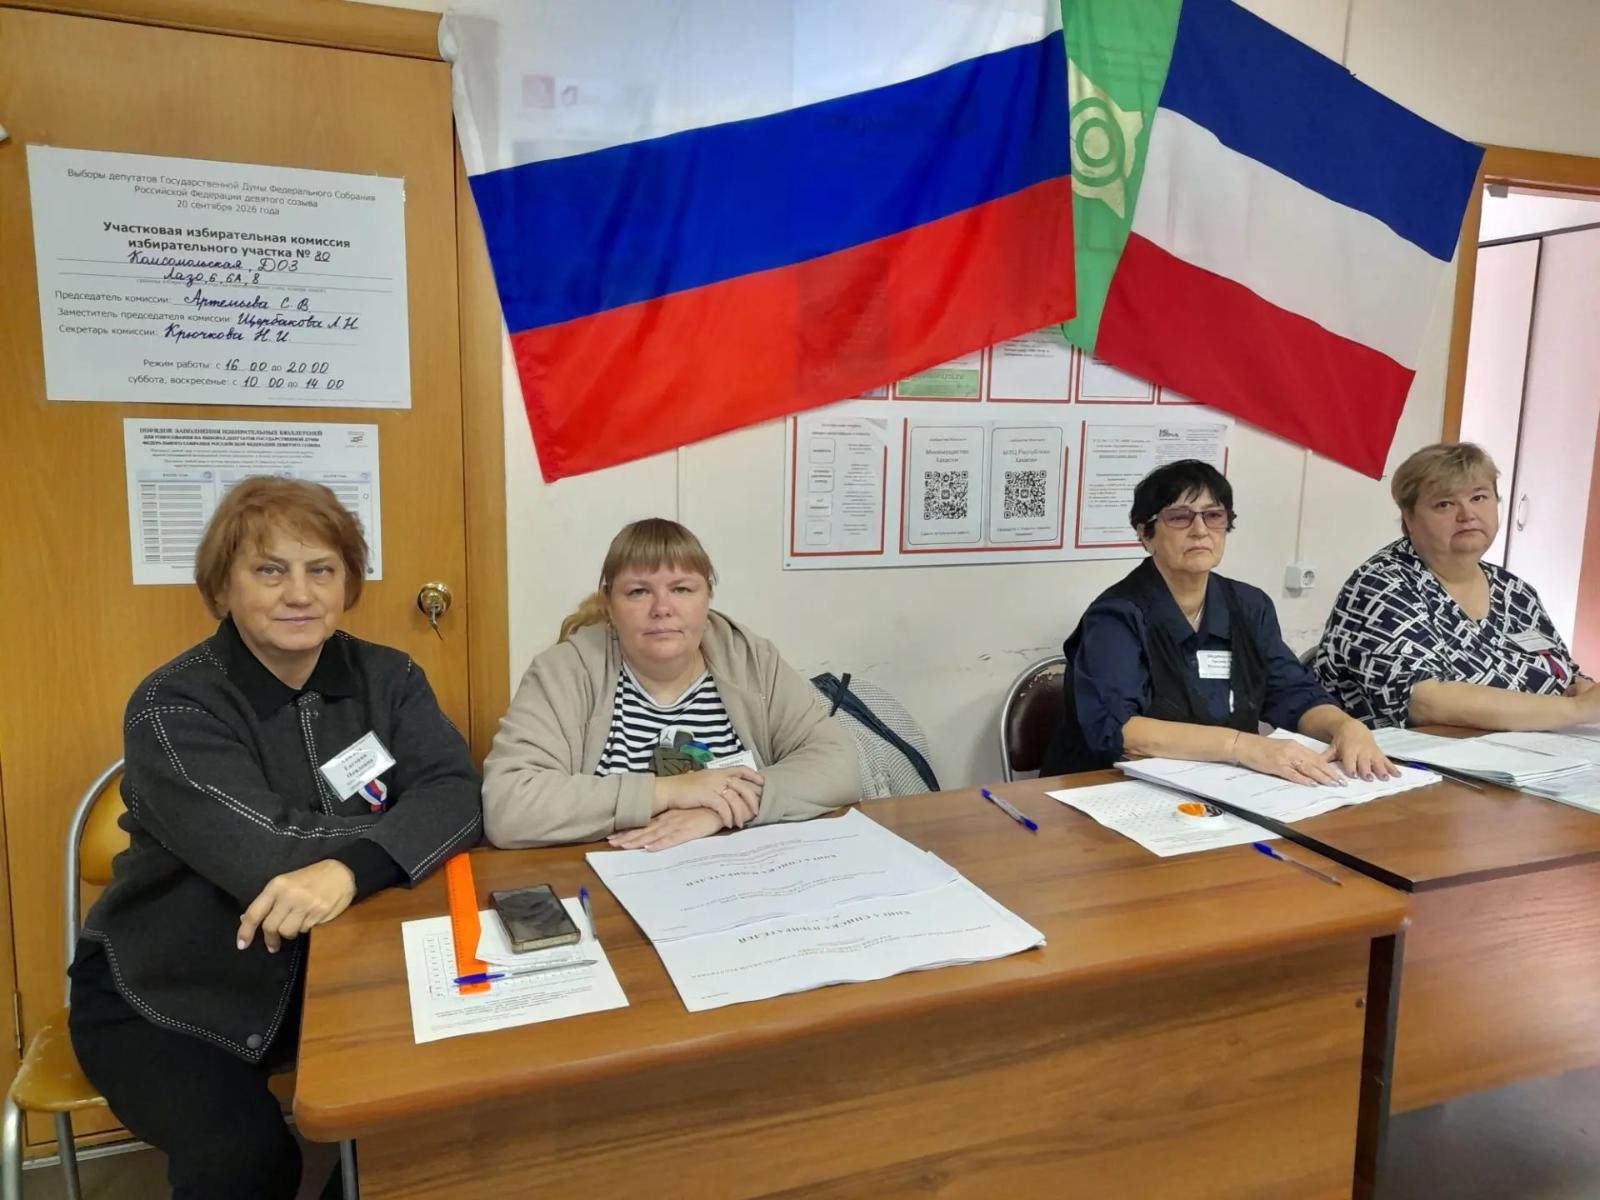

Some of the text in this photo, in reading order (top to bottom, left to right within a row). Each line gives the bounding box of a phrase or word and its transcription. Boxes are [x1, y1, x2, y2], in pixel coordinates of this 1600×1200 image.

[67, 168, 376, 202] Выборы депутатов Государственной Думы Федерального Собрания
[134, 185, 318, 208] Российской Федерации девятого созыва
[176, 200, 280, 216] 20 сентября 2026 года
[103, 221, 351, 248] Участковая избирательная комиссия
[128, 239, 238, 255] избирательного
[241, 246, 292, 258] участка
[296, 249, 311, 259] №
[54, 290, 122, 302] Председатель
[58, 307, 118, 318] Заместитель
[120, 310, 185, 322] председателя
[237, 312, 323, 331] Щербакова
[59, 324, 108, 335] Секретарь
[165, 322, 245, 344] Крючкова
[143, 358, 174, 368] Режим
[225, 358, 240, 371] 16
[250, 361, 268, 372] 00
[271, 364, 282, 372] до
[286, 361, 307, 374] 20
[311, 361, 330, 374] 00
[127, 374, 167, 385] суббота,
[243, 376, 259, 388] 10
[268, 377, 285, 388] 00
[305, 377, 320, 389] 14
[326, 379, 345, 390] 00
